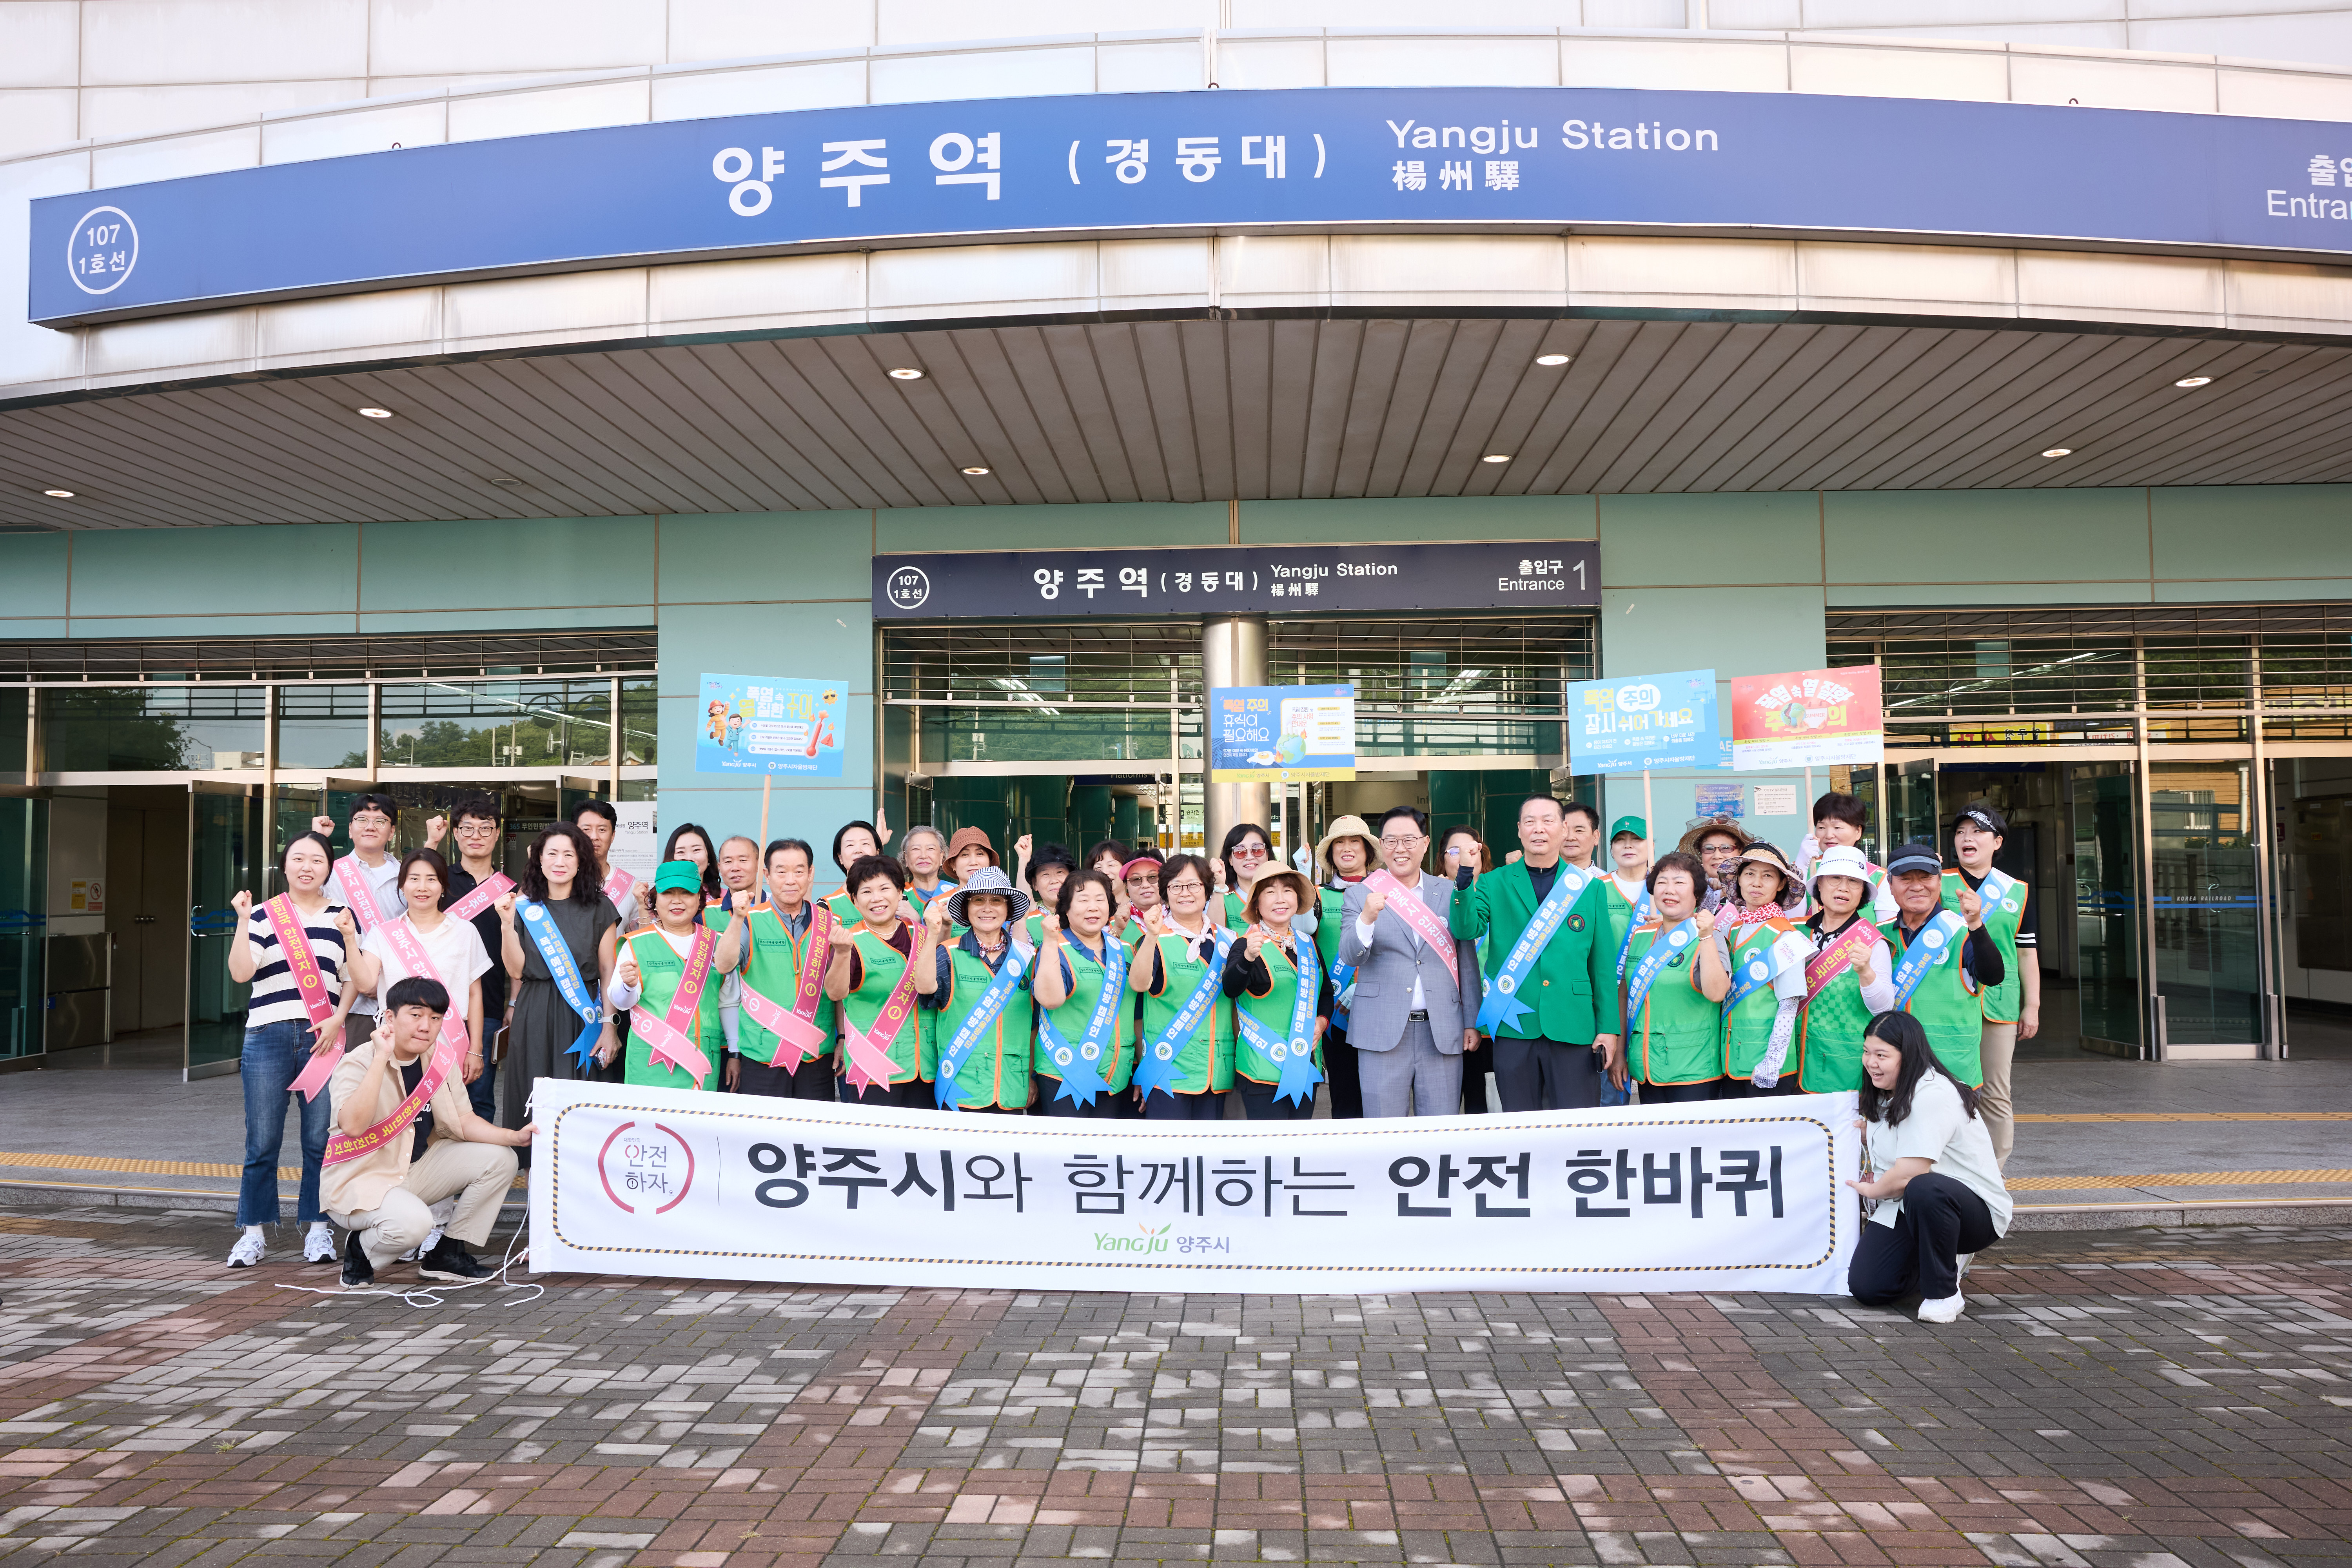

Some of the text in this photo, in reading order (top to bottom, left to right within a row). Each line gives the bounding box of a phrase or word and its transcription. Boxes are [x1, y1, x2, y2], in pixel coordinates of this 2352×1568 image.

[1387, 118, 1720, 155] Yangju Station
[712, 131, 1327, 217] 양주역 (경동대)
[1392, 158, 1520, 193] 楊州驛
[2267, 189, 2352, 220] Entra
[85, 222, 122, 248] 107
[78, 249, 127, 277] 1호선
[898, 575, 920, 586] 107
[1270, 562, 1398, 579] Yangju Station
[1498, 562, 1585, 591] Entrance 1
[1518, 558, 1564, 575] 출입구
[893, 587, 925, 601] 1호선
[1033, 566, 1259, 600] 양주역 (경동대)
[1270, 582, 1320, 597] 楊州驛
[747, 686, 784, 703] 폭염 속
[1223, 699, 1269, 712] 폭염 주의
[1584, 688, 1654, 713] 폭염 주의
[1755, 678, 1855, 709] 폭염 속 열 질환
[757, 702, 784, 718] 질환
[1223, 713, 1258, 728] 휴식이
[1585, 708, 1693, 735] 잠시 쉬어 가세요
[1223, 727, 1270, 743] 필요해요
[1654, 755, 1695, 764] 양주시자율방재단
[628, 821, 648, 829] 양주역
[338, 862, 379, 927] 양주시 안전하자
[458, 891, 489, 917] 양주시
[1388, 887, 1454, 957] 양주시 안전하자
[1507, 900, 1558, 972] 폭염 예방 캠페인
[1524, 894, 1574, 962] 양주시 지역자율방재단
[283, 927, 311, 971] 안전하자
[392, 928, 418, 960] 양주시
[542, 920, 580, 989] 양주시 지역자율방재단
[809, 936, 826, 981] 안전하자
[539, 936, 582, 1007] 폭염 예방 캠페인
[690, 941, 710, 980] 안전하자
[1653, 950, 1673, 970] 양주시
[1896, 961, 1914, 984] 폭염
[1912, 953, 1932, 976] 양주시
[1630, 955, 1655, 998] 폭염 예방
[1735, 981, 1752, 998] 양주시
[1089, 961, 1117, 1038] 폭염 예방 캠페인
[1104, 973, 1123, 1025] 지역자율방재단
[1166, 970, 1217, 1040] 폭염 예방 캠페인
[1184, 984, 1219, 1032] 지역자율방재단
[1295, 956, 1309, 1033] 폭염 예방 캠페인
[1306, 967, 1316, 1019] 지역자율방재단
[948, 986, 1000, 1057] 폭염 예방 캠페인
[964, 980, 1014, 1049] 양주시 지역자율방재단
[1243, 1026, 1268, 1050] 캠페인
[334, 1096, 422, 1156] 대한민국 안전하자
[625, 1144, 667, 1168] 안전
[625, 1172, 668, 1194] 하자
[747, 1142, 1784, 1220] 양주시와 함께하는 안전 한바퀴
[1176, 1235, 1230, 1255] 양주시
